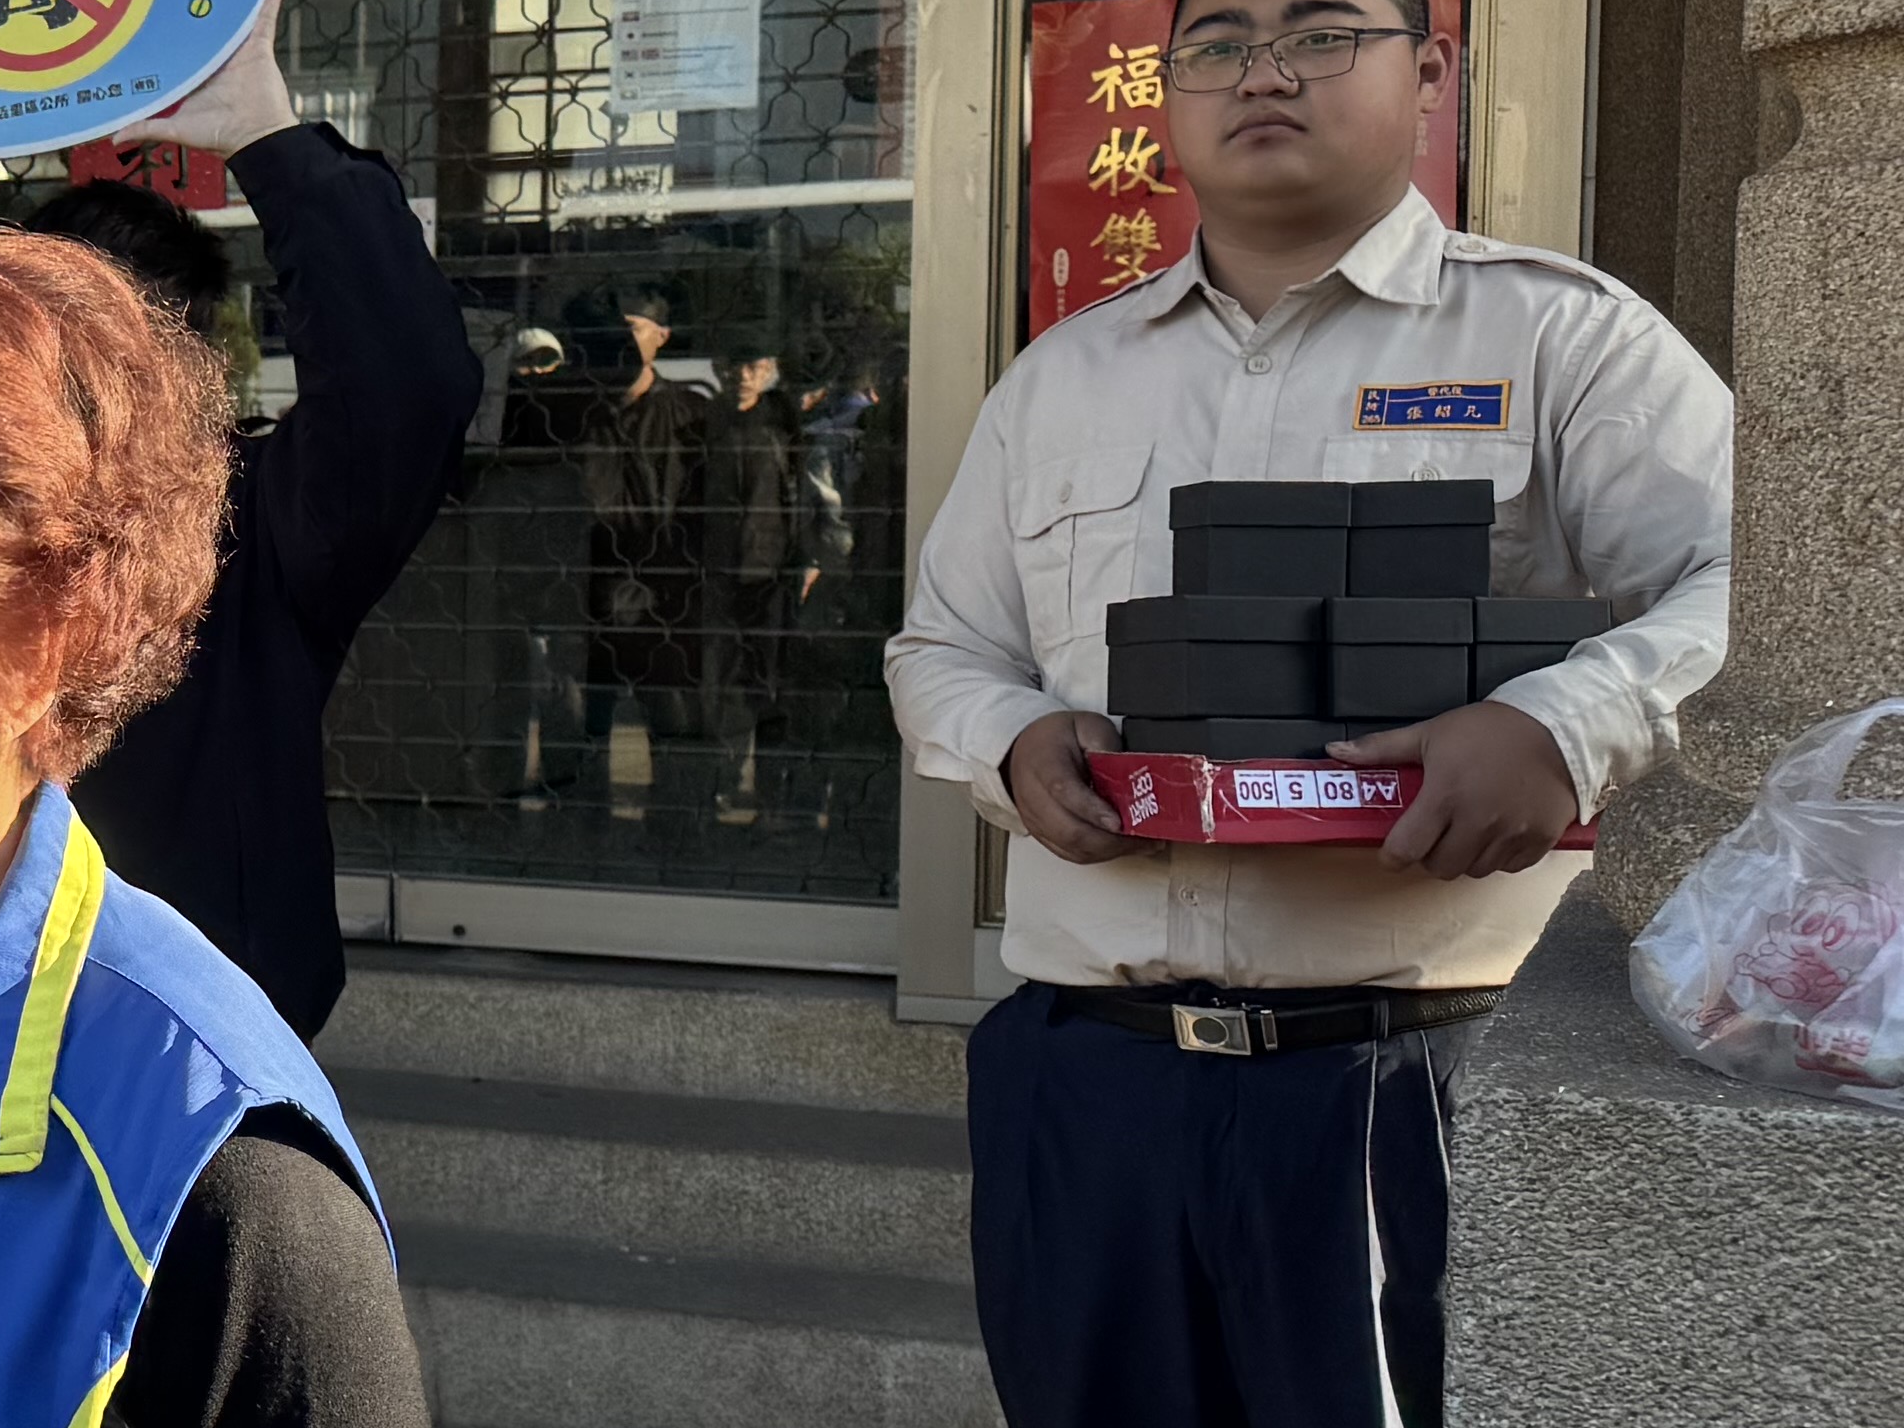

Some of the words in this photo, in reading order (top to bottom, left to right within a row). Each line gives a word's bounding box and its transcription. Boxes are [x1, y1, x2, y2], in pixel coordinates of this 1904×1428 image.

[1240, 782, 1272, 800] 500
[1289, 782, 1303, 800] 5
[1324, 781, 1354, 800] 80
[1363, 781, 1397, 801] A4
